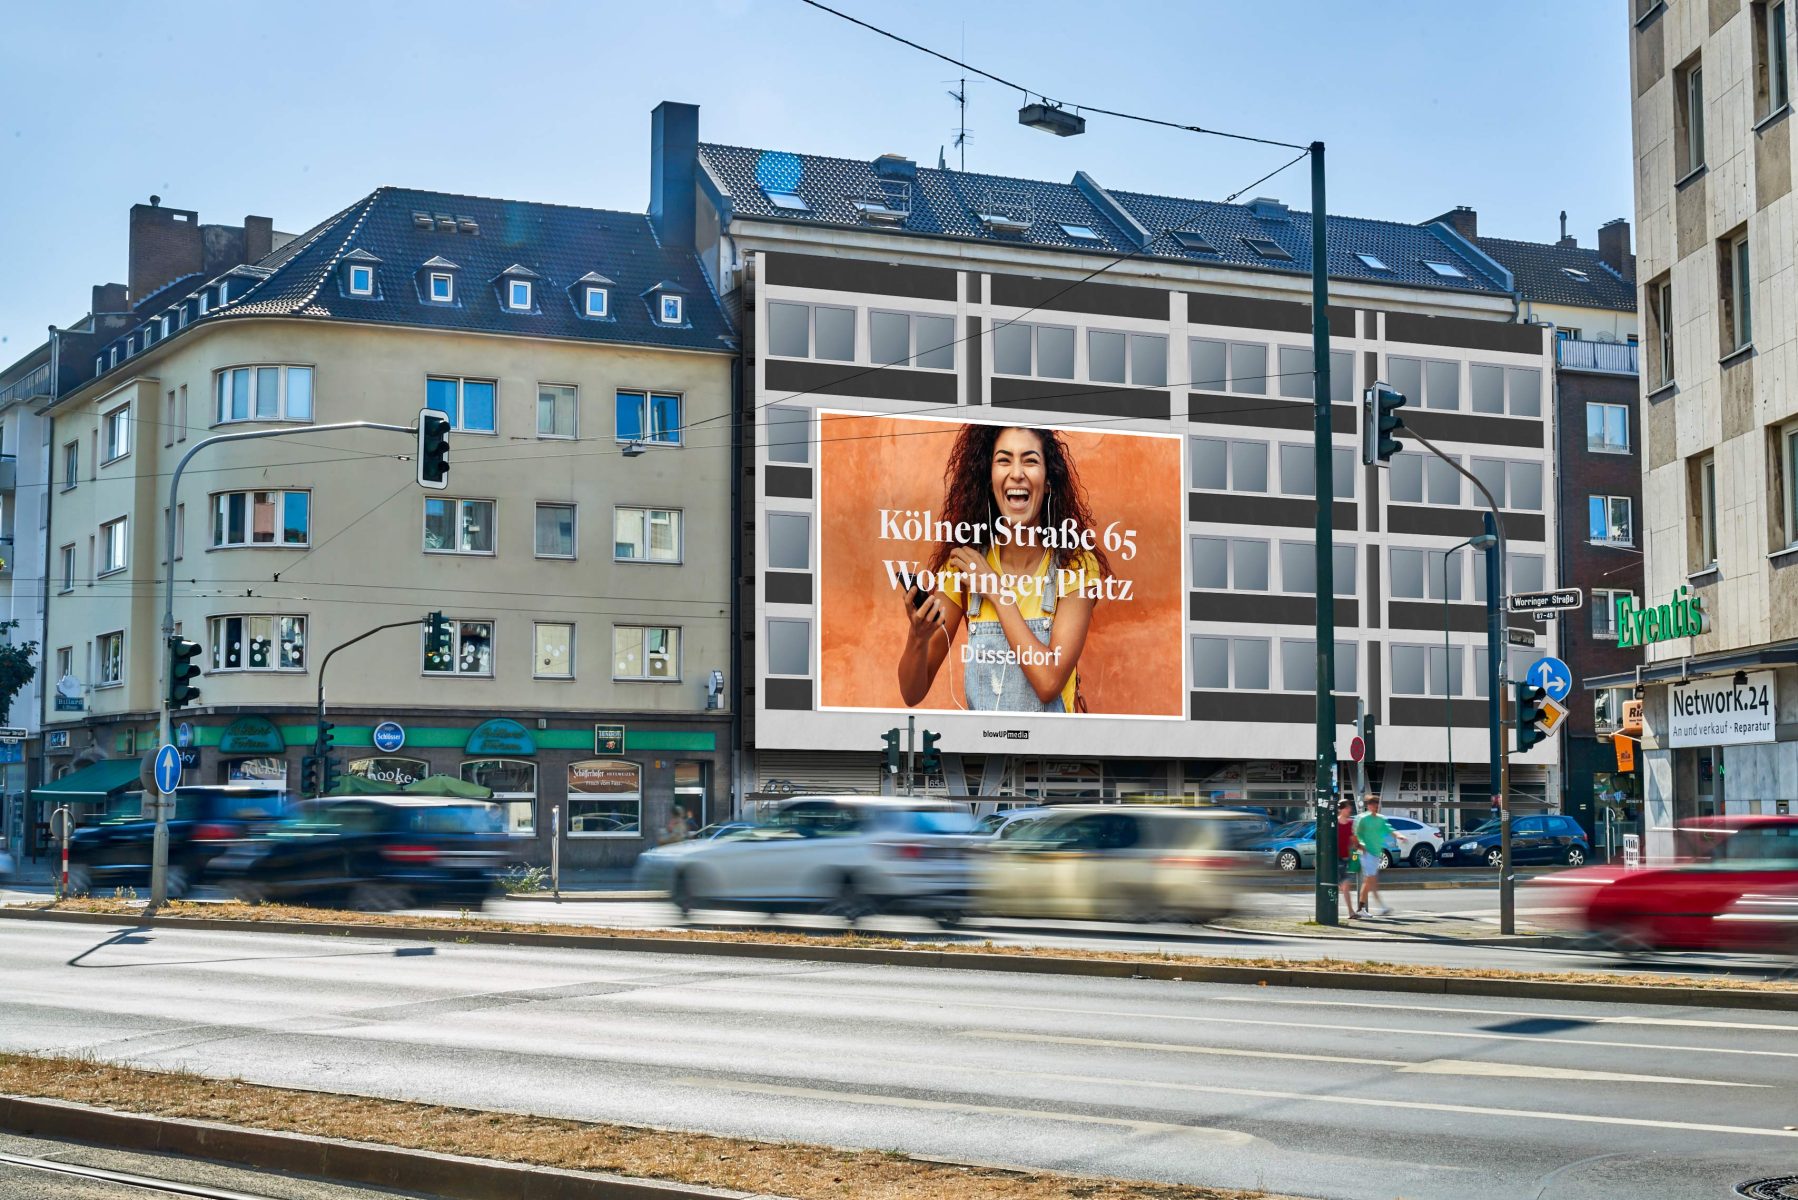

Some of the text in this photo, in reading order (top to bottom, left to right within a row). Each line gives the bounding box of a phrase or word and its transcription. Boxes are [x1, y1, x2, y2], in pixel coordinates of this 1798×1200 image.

[878, 509, 1137, 561] Kölner Straße 65
[882, 560, 1134, 606] Worringer Platz
[1514, 594, 1574, 607] Worringer Straße
[1616, 585, 1703, 648] Eventis
[961, 644, 1062, 666] Düsseldorf
[1673, 685, 1769, 717] Network.24
[1673, 721, 1770, 737] An und verkauf Reparatur
